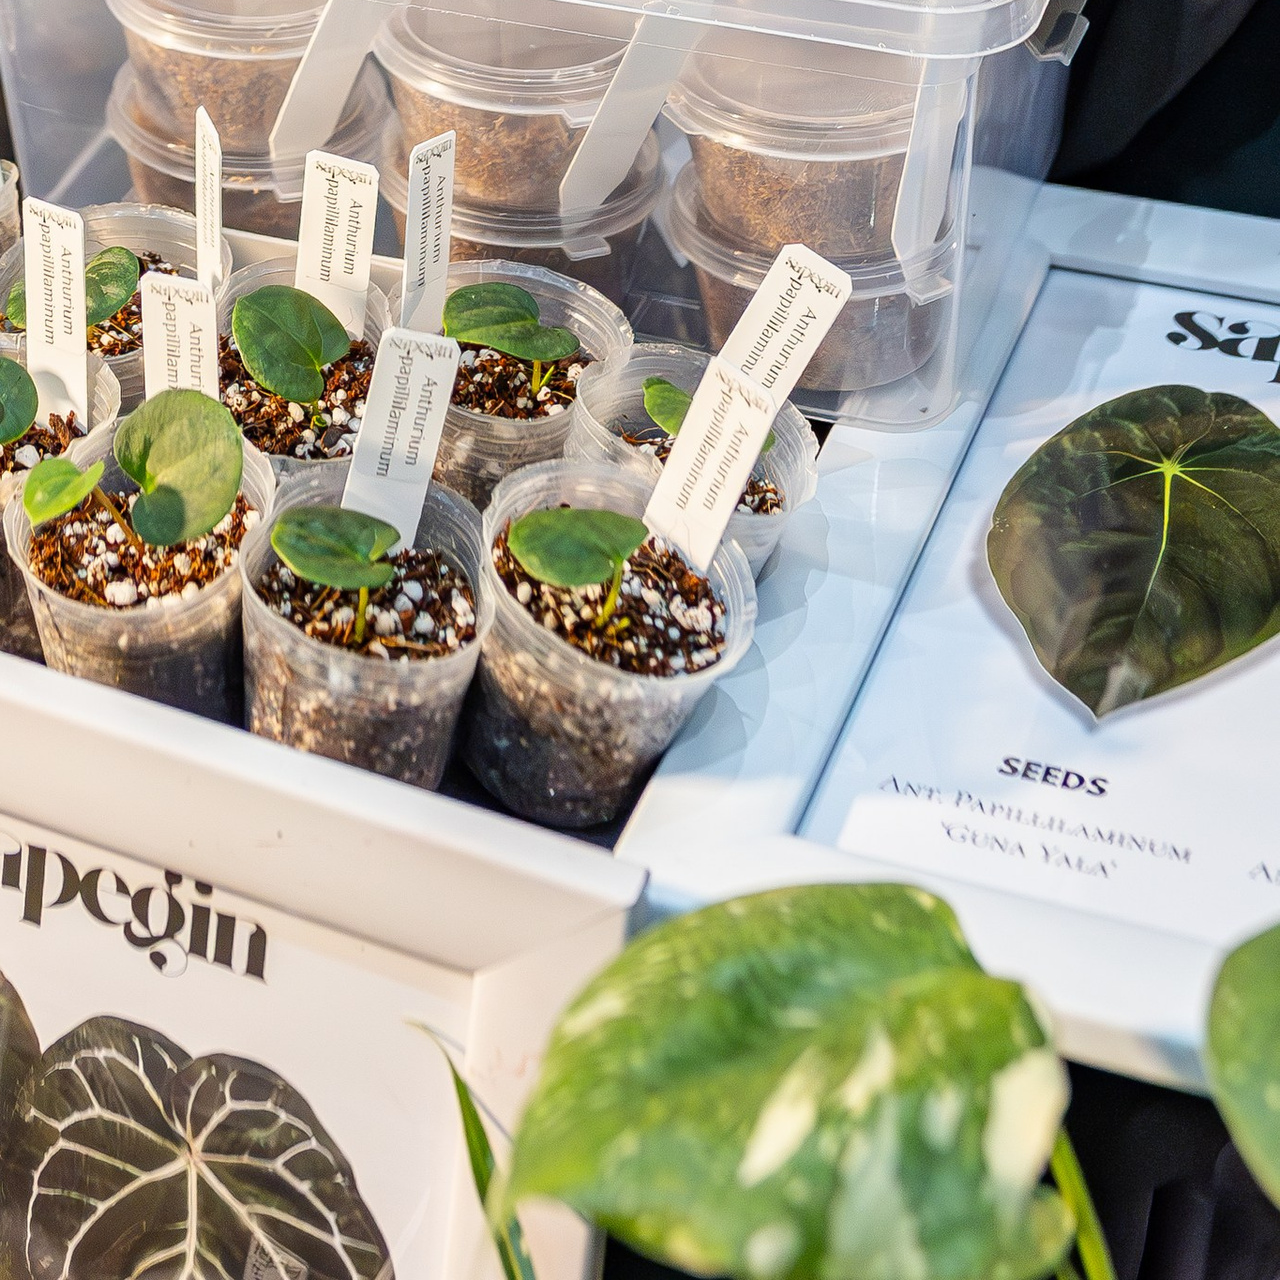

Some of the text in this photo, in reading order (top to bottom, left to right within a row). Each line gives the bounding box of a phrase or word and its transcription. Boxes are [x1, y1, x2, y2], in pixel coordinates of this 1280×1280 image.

[343, 198, 363, 275] Anthurium
[432, 174, 446, 264] Anthurium
[60, 245, 74, 336] Anthurium
[740, 275, 803, 377] papillilaminu
[188, 322, 204, 392] Anthuri
[760, 306, 817, 390] Anthurium
[405, 376, 433, 466] Anthurium
[702, 421, 749, 512] Anthurium
[998, 756, 1109, 797] SEEDS
